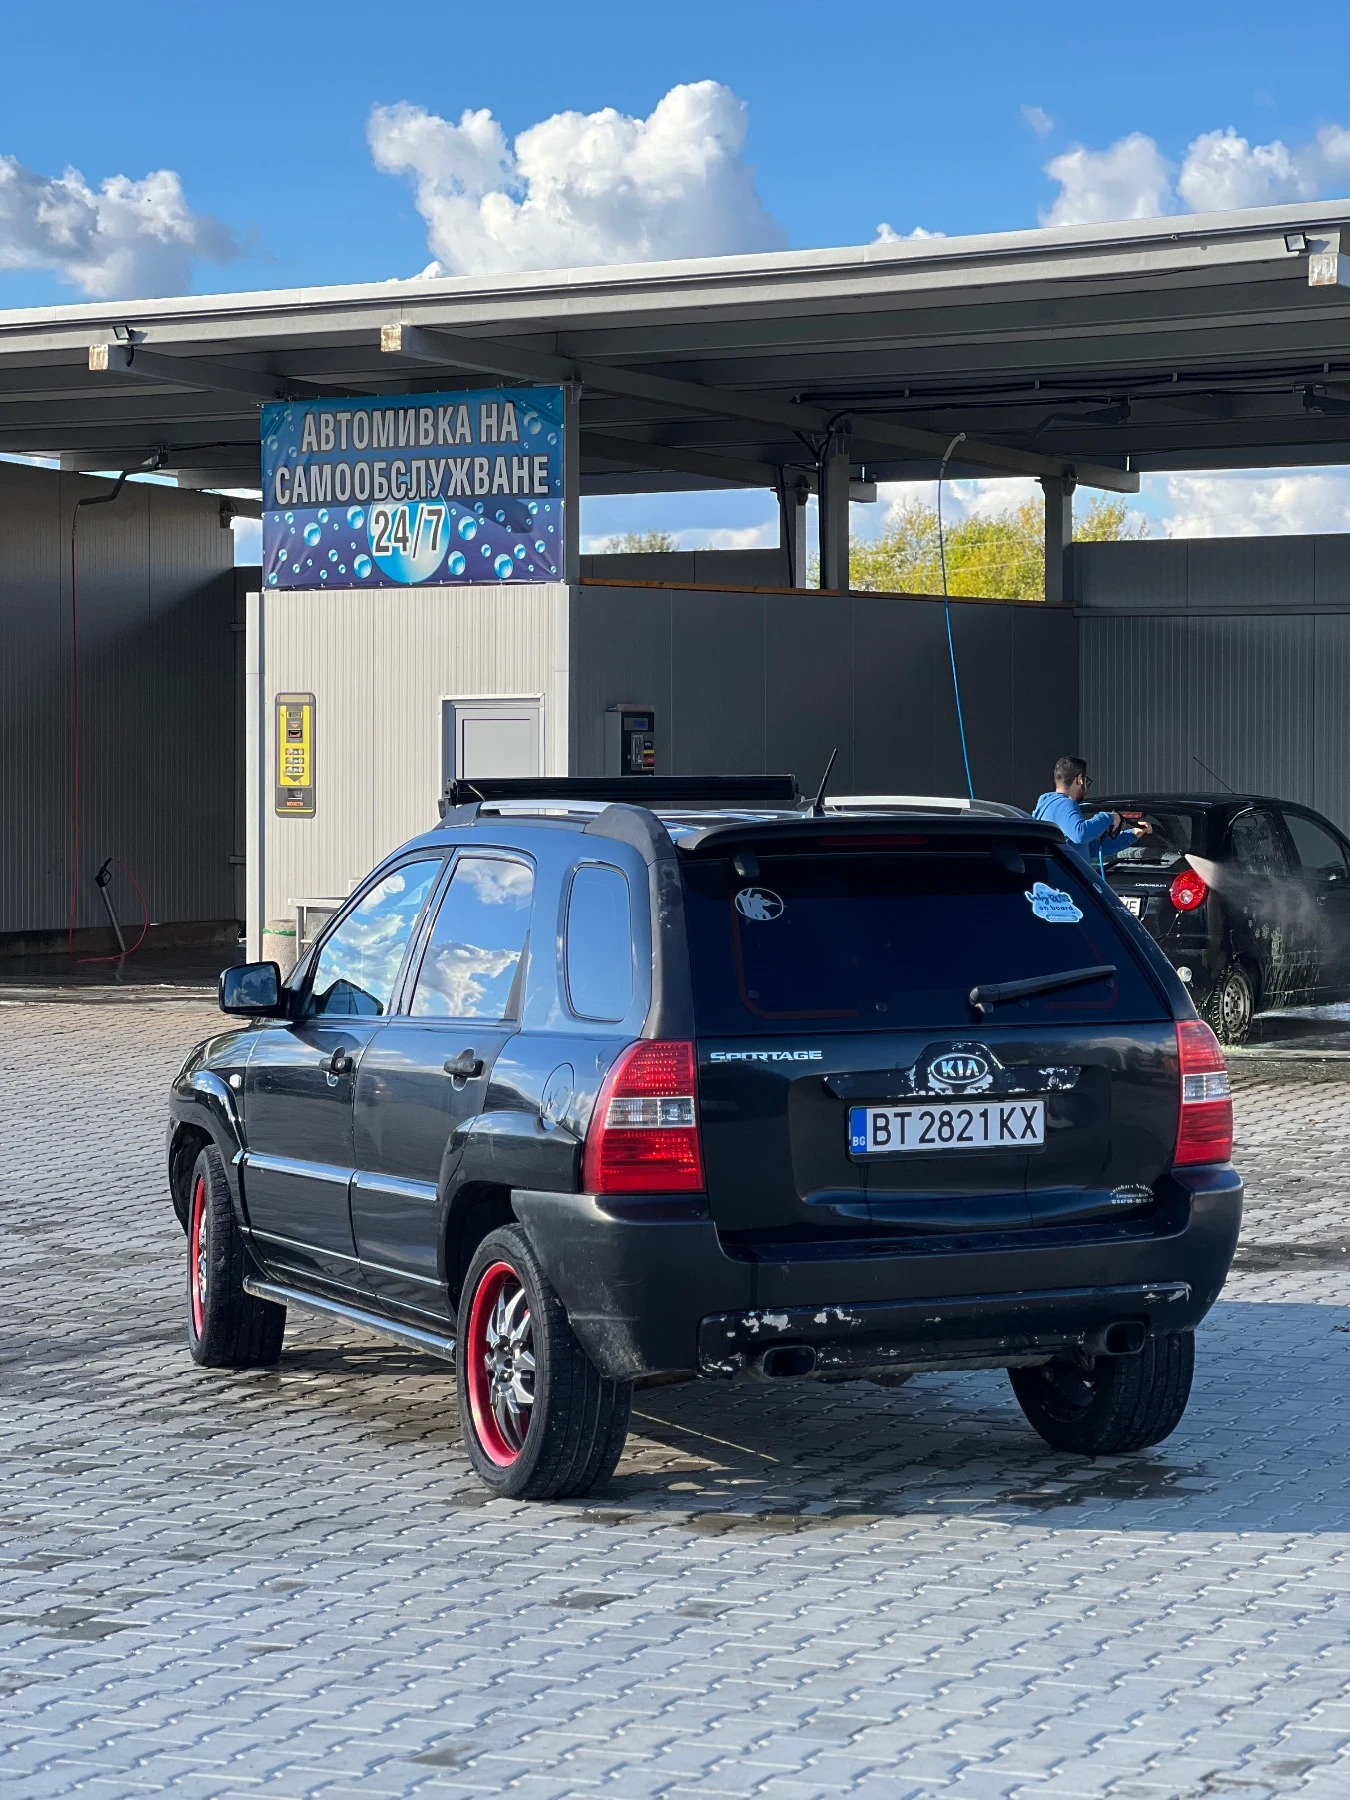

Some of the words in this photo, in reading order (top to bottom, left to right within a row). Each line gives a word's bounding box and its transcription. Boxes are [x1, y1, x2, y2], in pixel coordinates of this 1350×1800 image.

[301, 404, 472, 452] АВТОМИВКА
[479, 402, 519, 442] НА
[275, 456, 549, 505] САМООБСЛУЖВАНЕ
[373, 504, 445, 559] 24/7
[710, 1050, 823, 1063] SPORTAGE
[941, 1059, 980, 1077] KIA
[852, 1136, 866, 1147] BG
[872, 1111, 912, 1146] BT
[918, 1108, 989, 1144] 2821
[999, 1105, 1038, 1140] KX
